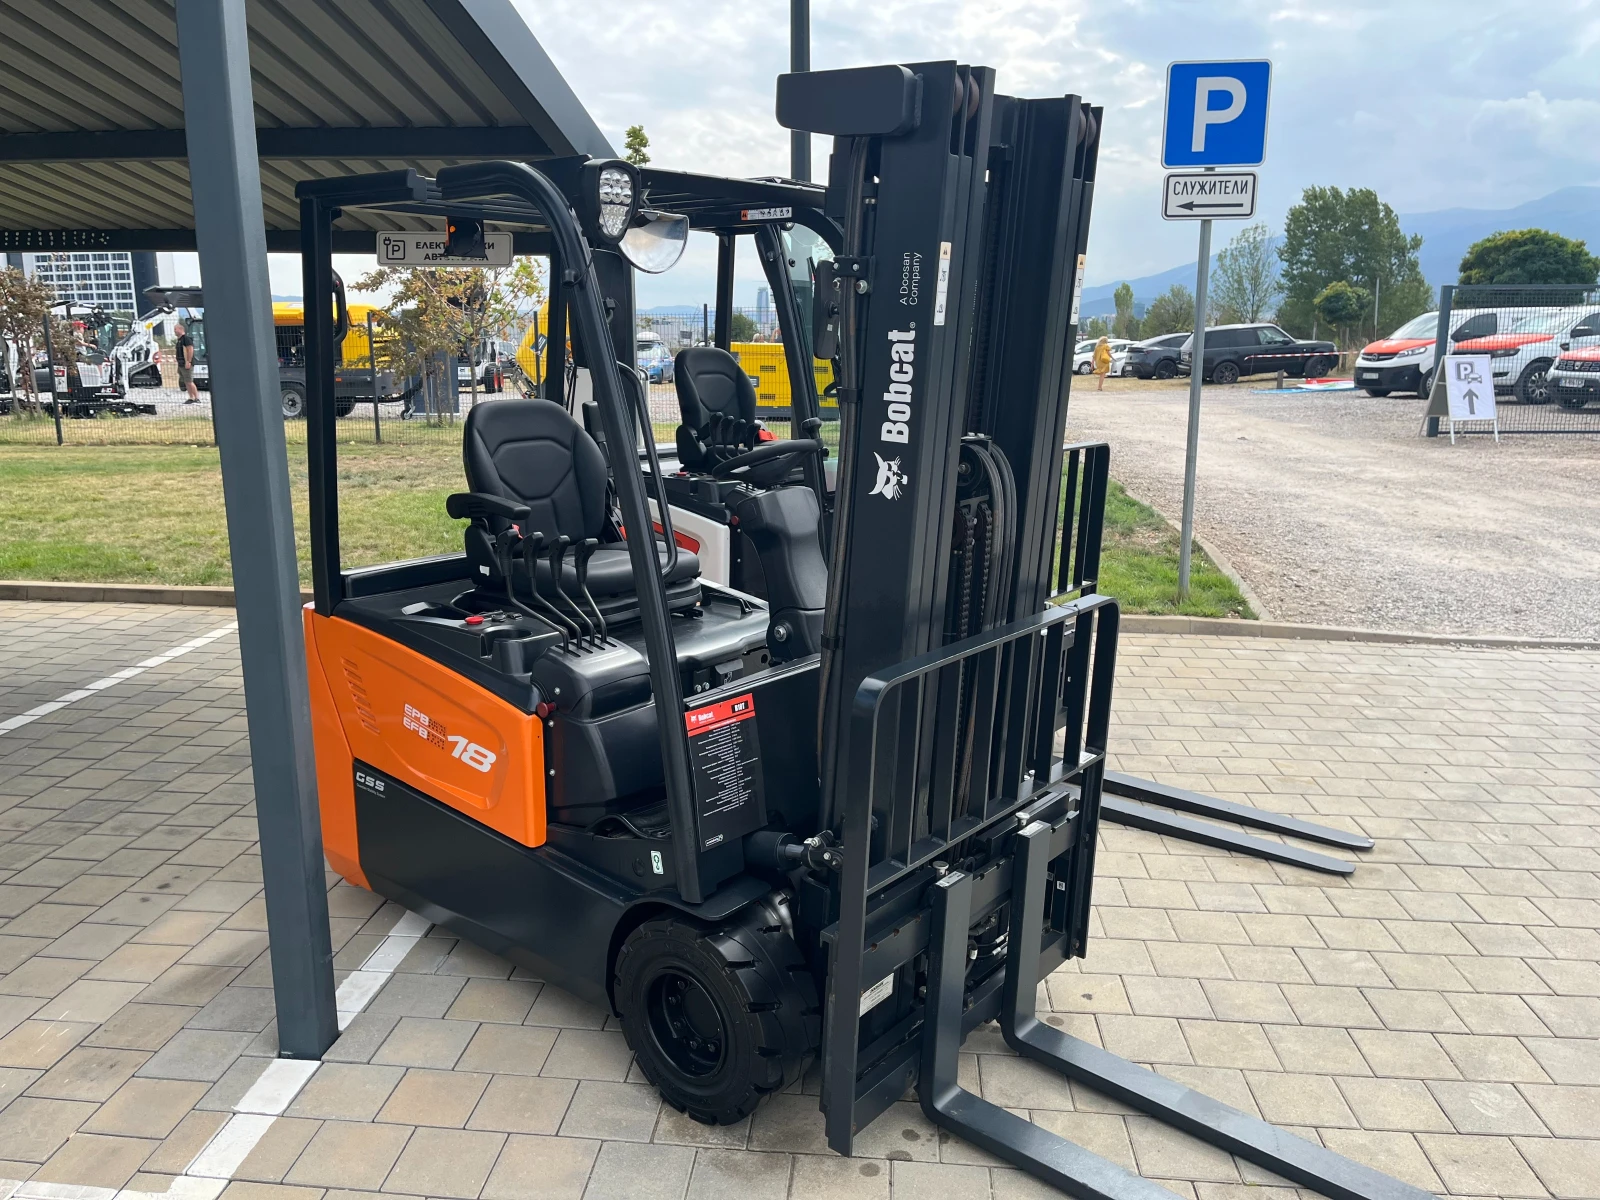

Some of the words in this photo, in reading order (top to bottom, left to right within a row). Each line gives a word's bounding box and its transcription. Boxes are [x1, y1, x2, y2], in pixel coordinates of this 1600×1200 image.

[1191, 76, 1247, 152] P
[1173, 180, 1248, 195] СЛУЖИТЕЛИ
[900, 252, 910, 295] Doosan
[909, 252, 922, 305] Company
[899, 297, 908, 305] A
[404, 703, 429, 726] EPB
[403, 716, 428, 739] EFB
[447, 735, 497, 773] 18
[355, 771, 385, 791] GSS
